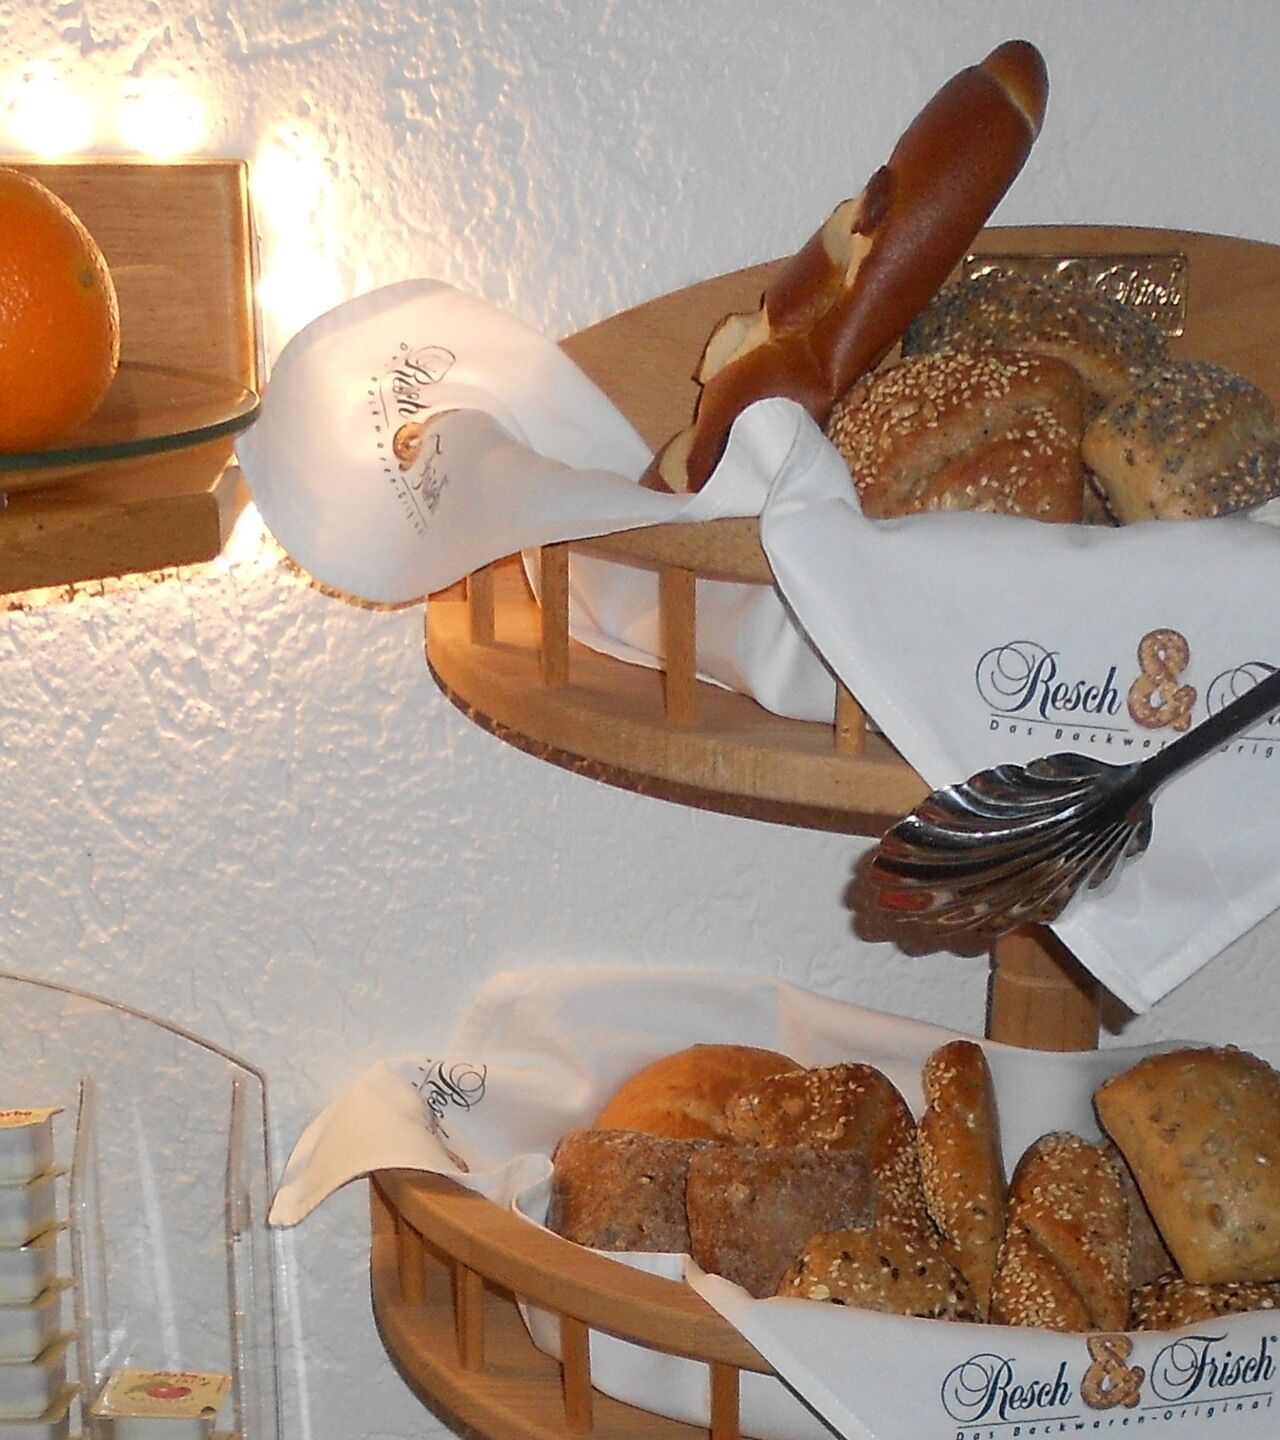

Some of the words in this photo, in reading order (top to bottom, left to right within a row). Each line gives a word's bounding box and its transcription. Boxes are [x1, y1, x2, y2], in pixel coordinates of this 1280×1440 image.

[975, 640, 1122, 720] Resch
[989, 719, 1034, 736] Das
[940, 1353, 1073, 1423] Resch
[1080, 1333, 1146, 1410] &
[1150, 1335, 1277, 1402] Frisch
[1013, 1397, 1273, 1437] Backwaren-Original
